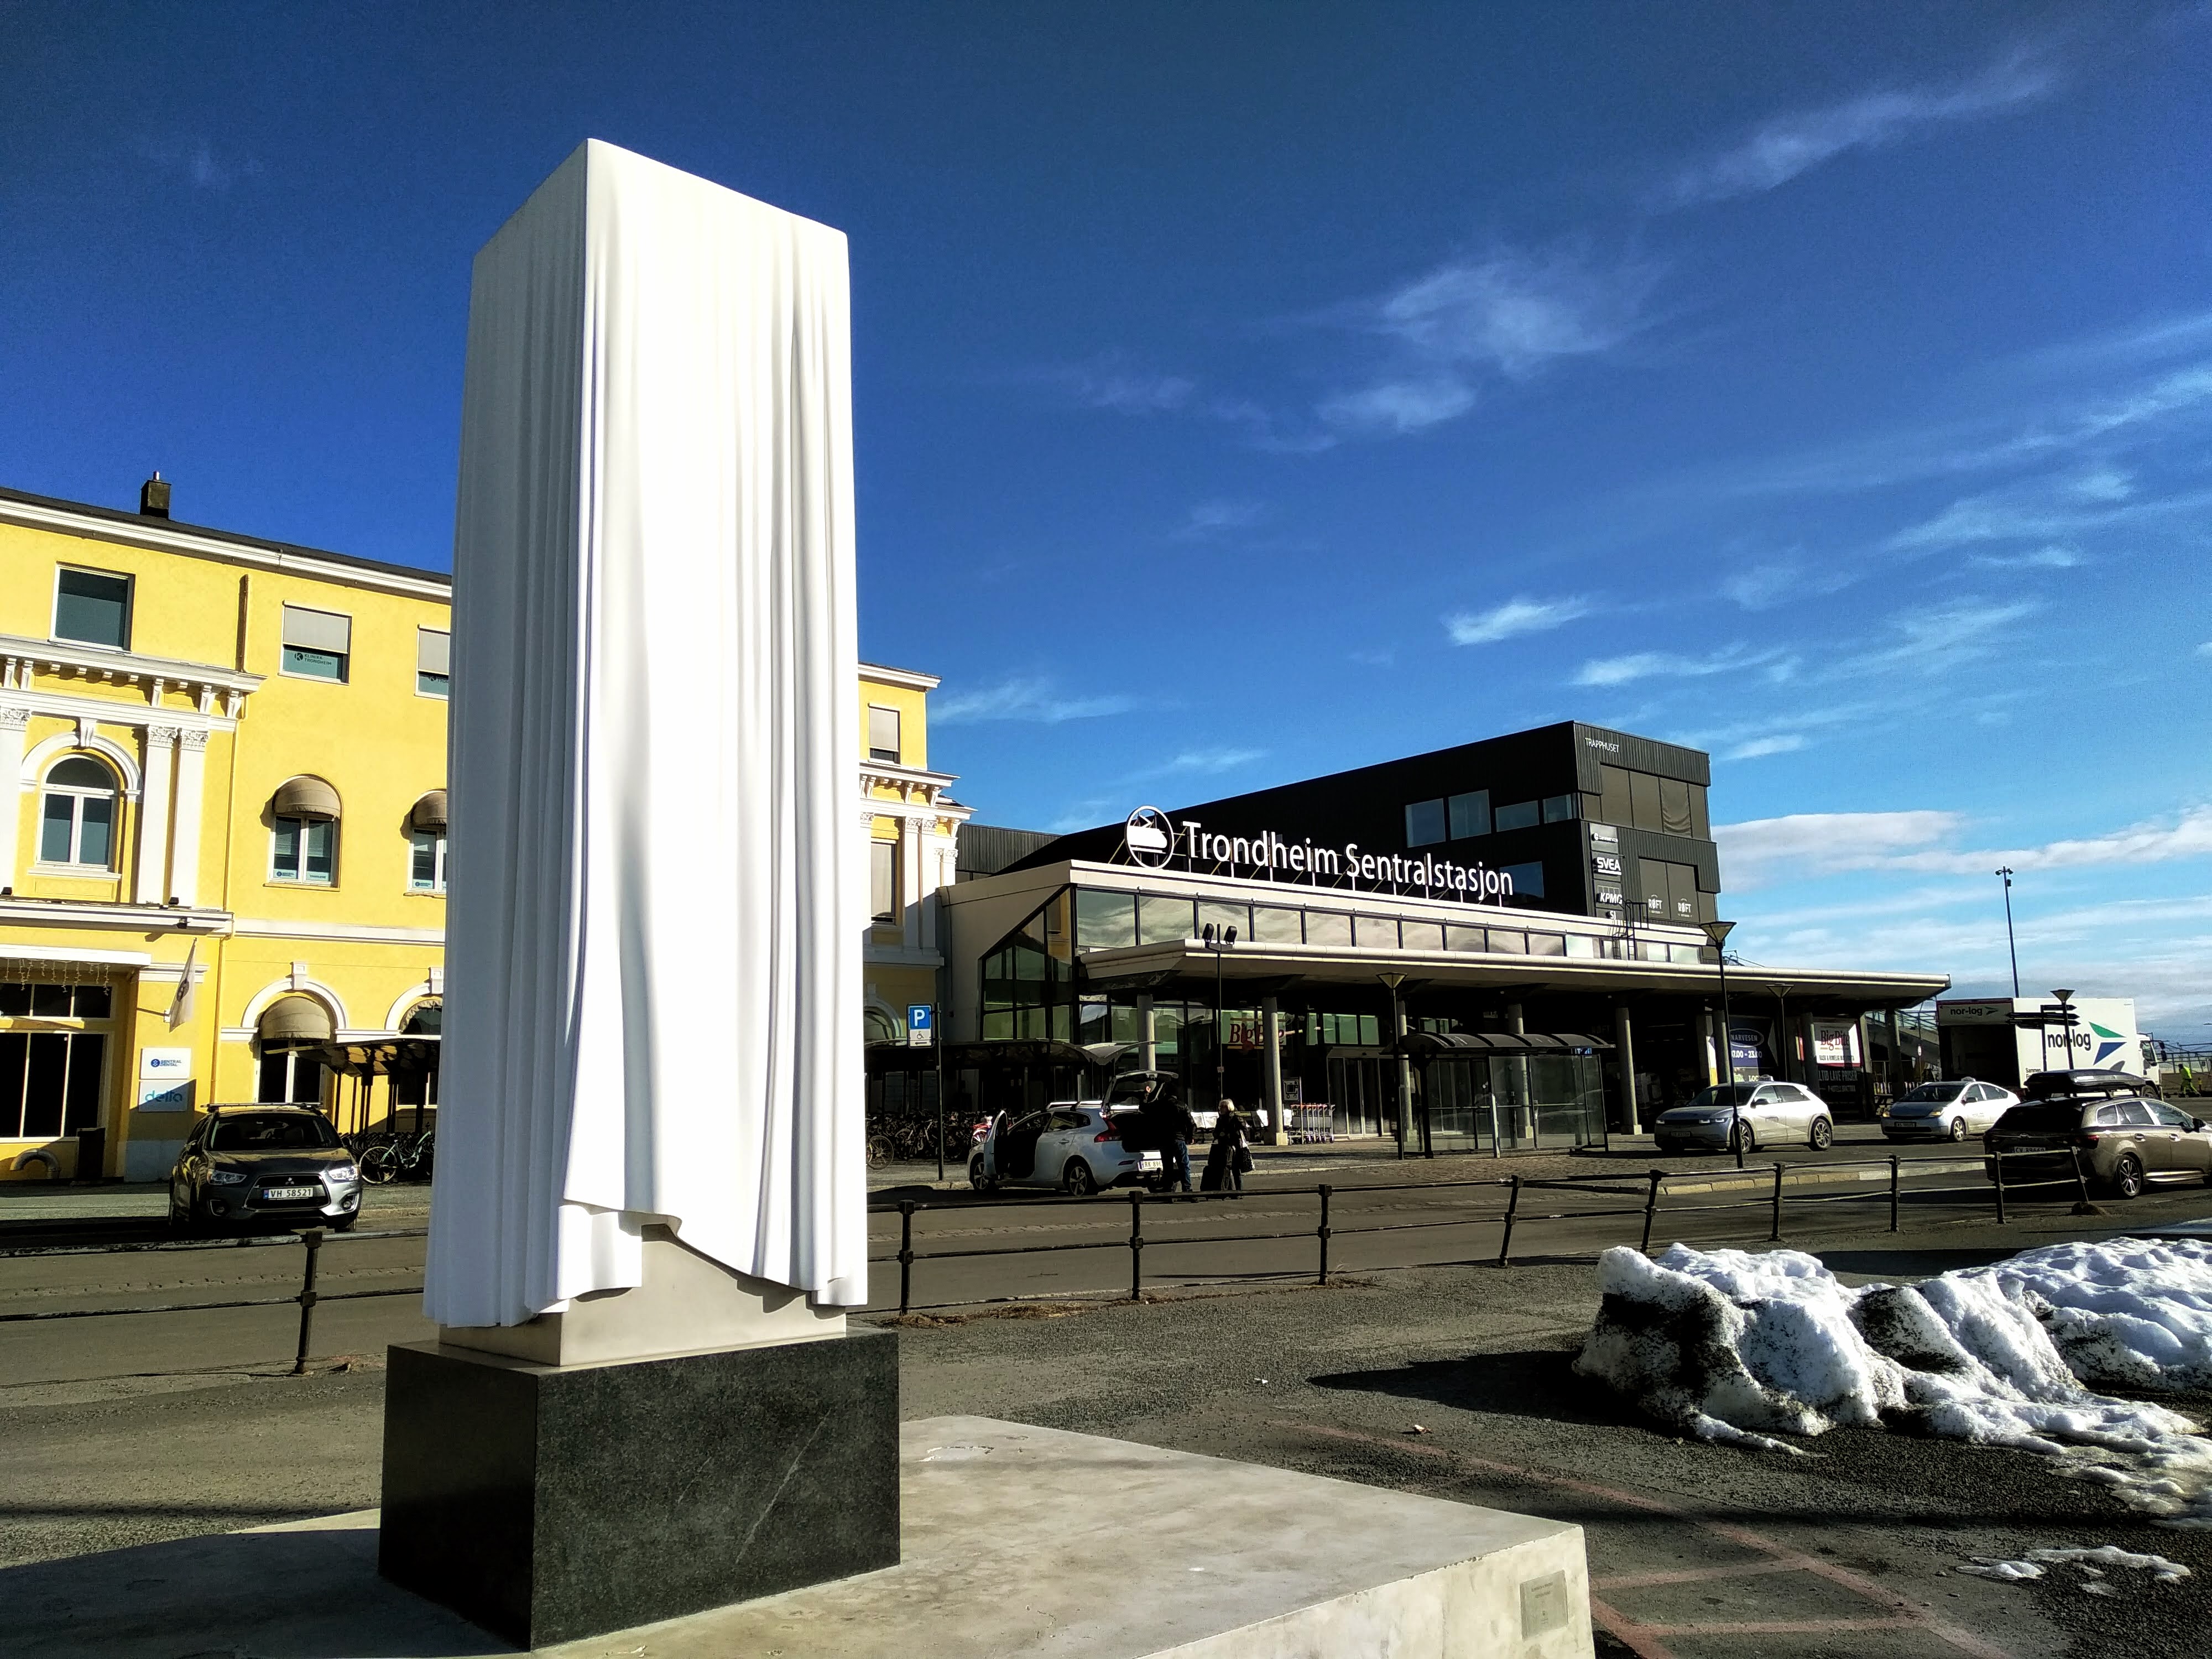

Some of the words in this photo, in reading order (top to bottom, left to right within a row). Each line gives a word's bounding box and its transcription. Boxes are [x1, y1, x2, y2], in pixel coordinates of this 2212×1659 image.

[1584, 737, 1619, 753] TRAPPHUSET
[1182, 821, 1338, 875] Trondheim
[1345, 843, 1513, 901] Sentralstasjon
[1597, 857, 1621, 871] SVEA
[1600, 892, 1623, 904] KPMG
[1648, 898, 1663, 910] RØFT
[1677, 902, 1692, 913] RØFT
[1950, 1006, 1983, 1016] nor-log
[914, 1009, 925, 1027] P
[1731, 1050, 1743, 1058] 7.00
[1748, 1050, 1762, 1058] 23.00
[286, 1188, 311, 1197] 58521
